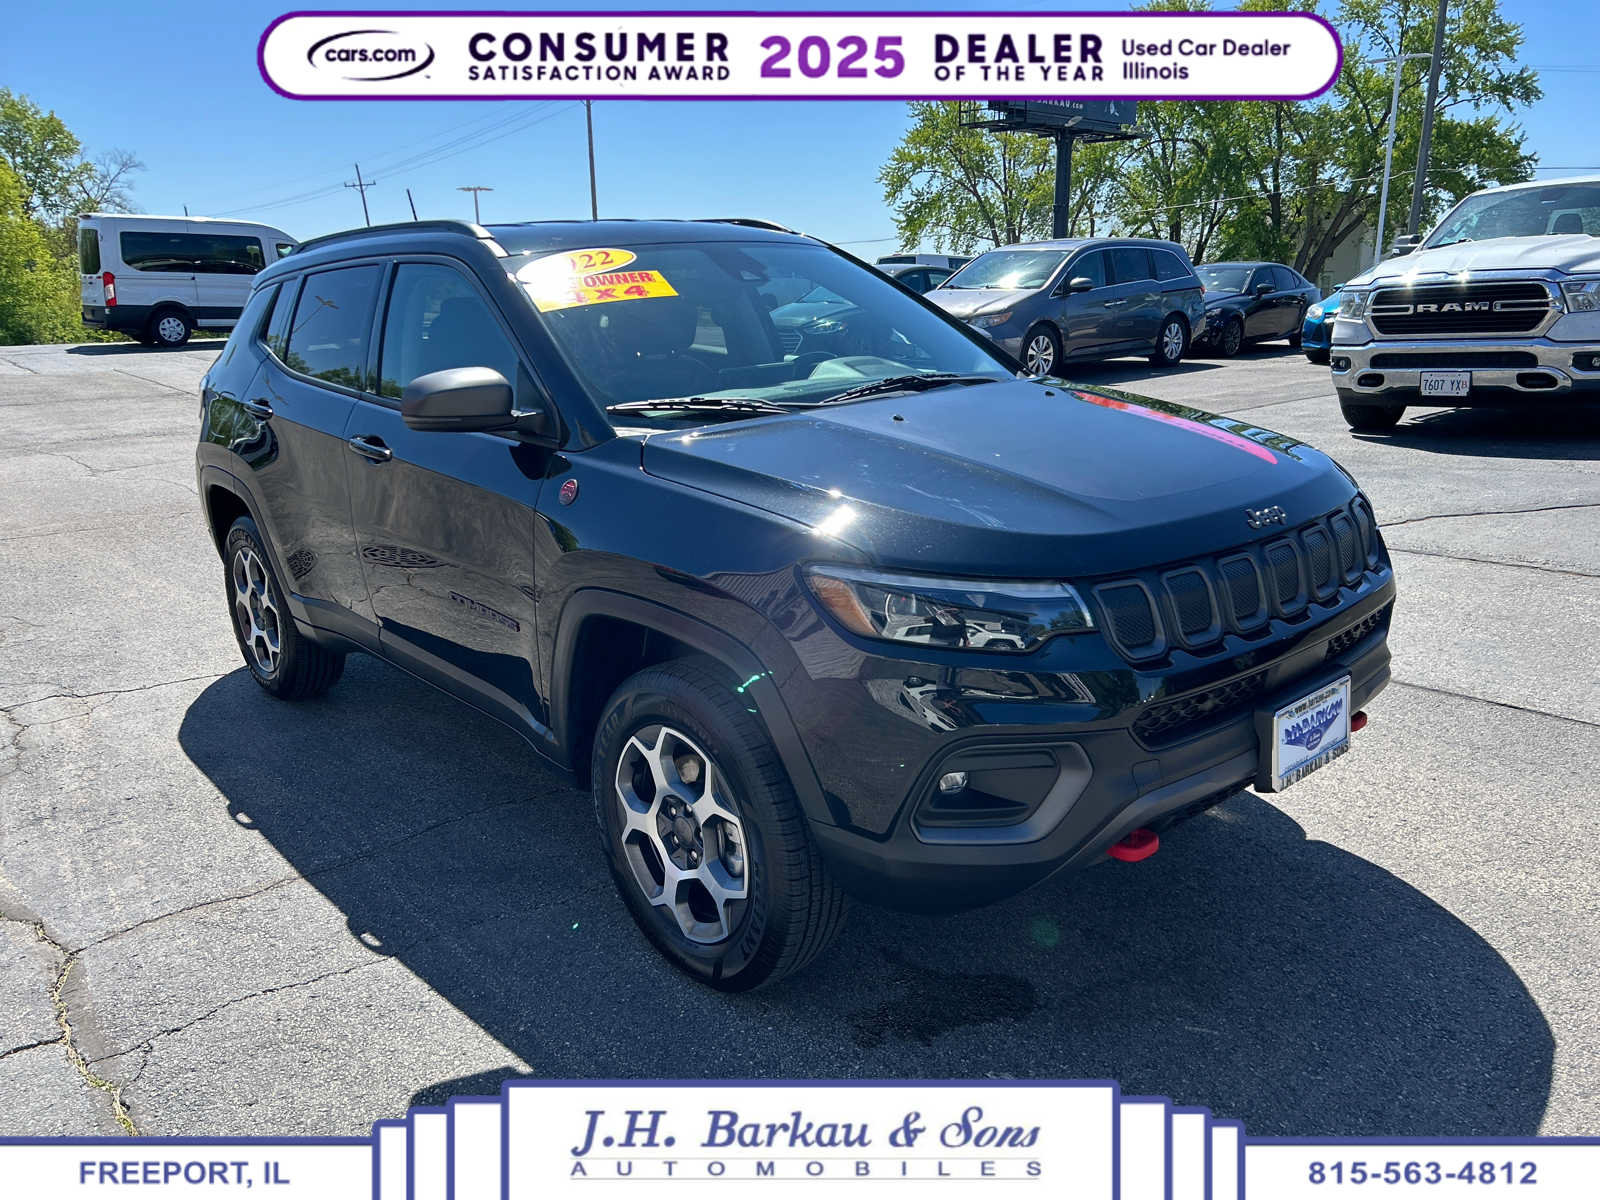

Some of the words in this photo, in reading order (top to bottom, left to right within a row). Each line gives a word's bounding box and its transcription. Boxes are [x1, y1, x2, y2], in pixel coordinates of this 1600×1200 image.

[583, 271, 656, 288] OWNER
[1416, 301, 1489, 313] RAM
[1423, 379, 1445, 391] 7607
